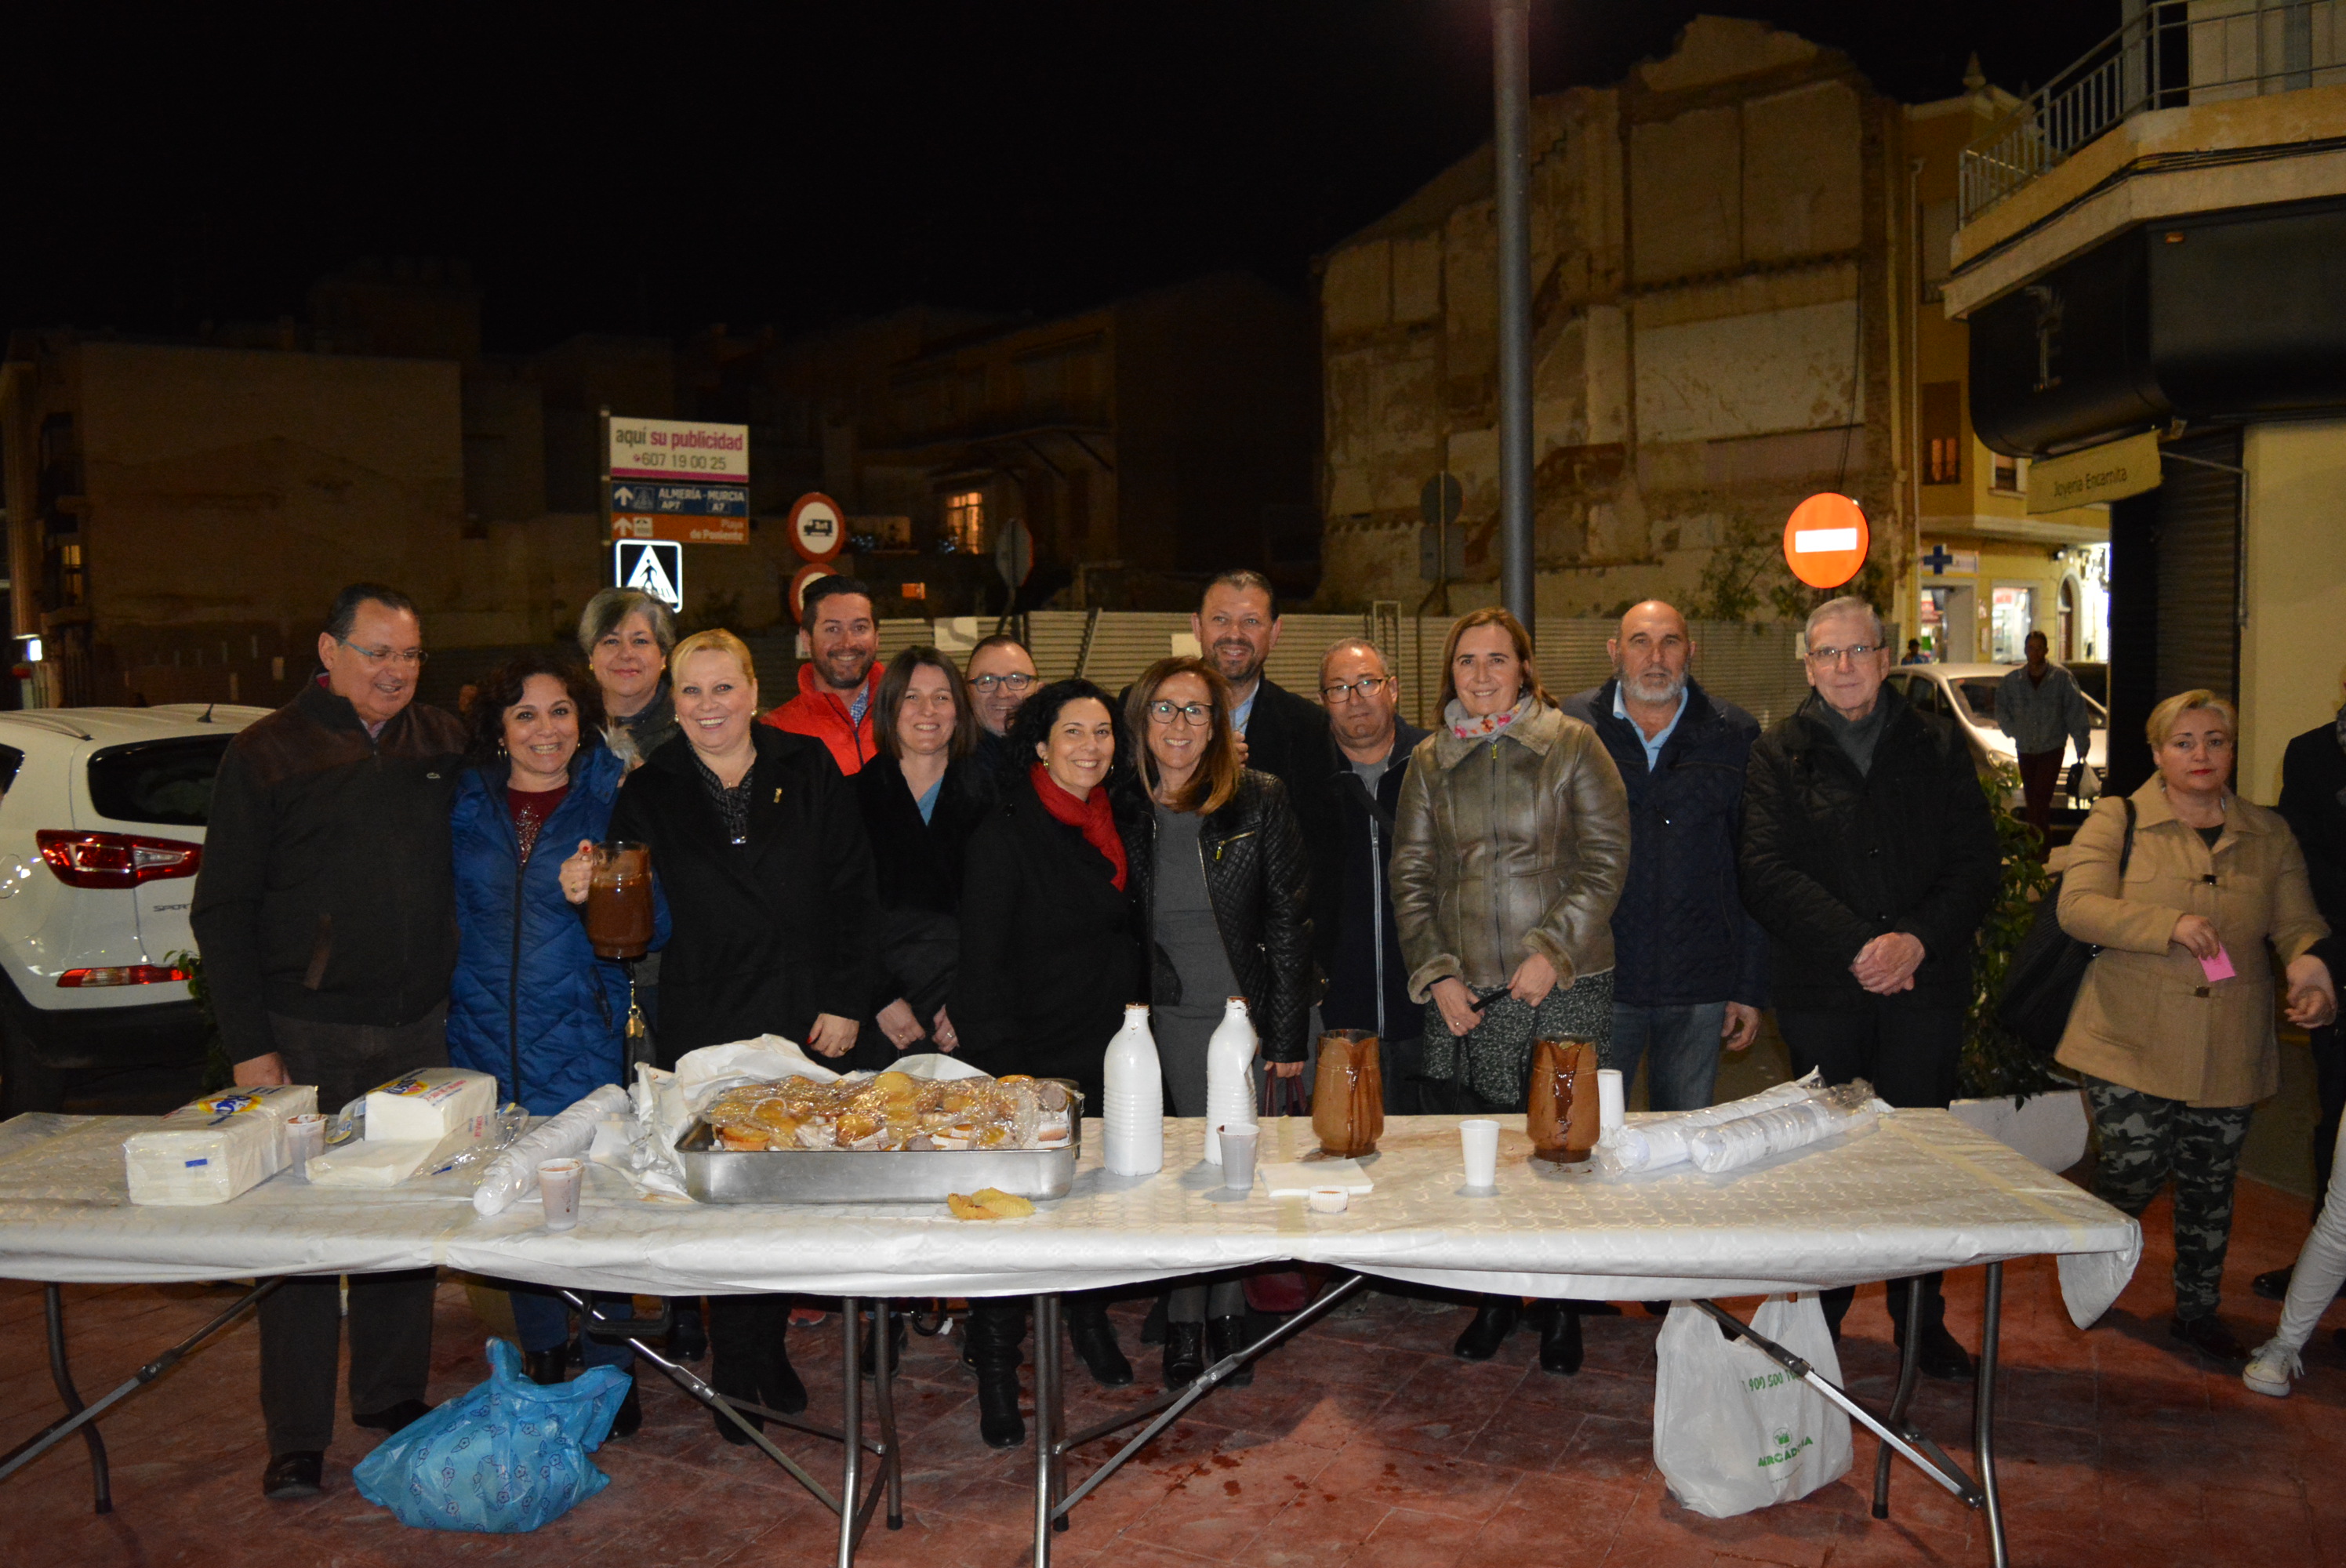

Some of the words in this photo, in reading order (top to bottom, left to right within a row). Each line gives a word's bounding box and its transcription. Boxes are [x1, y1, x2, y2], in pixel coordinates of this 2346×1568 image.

[616, 426, 646, 448] aquí
[650, 431, 666, 446] su
[670, 430, 743, 451] publicidad
[641, 452, 666, 466] 607
[672, 454, 687, 469] 19
[690, 455, 706, 470] 00
[710, 456, 727, 470] 25
[707, 489, 745, 502] MURCIA
[1767, 1372, 1784, 1388] 500
